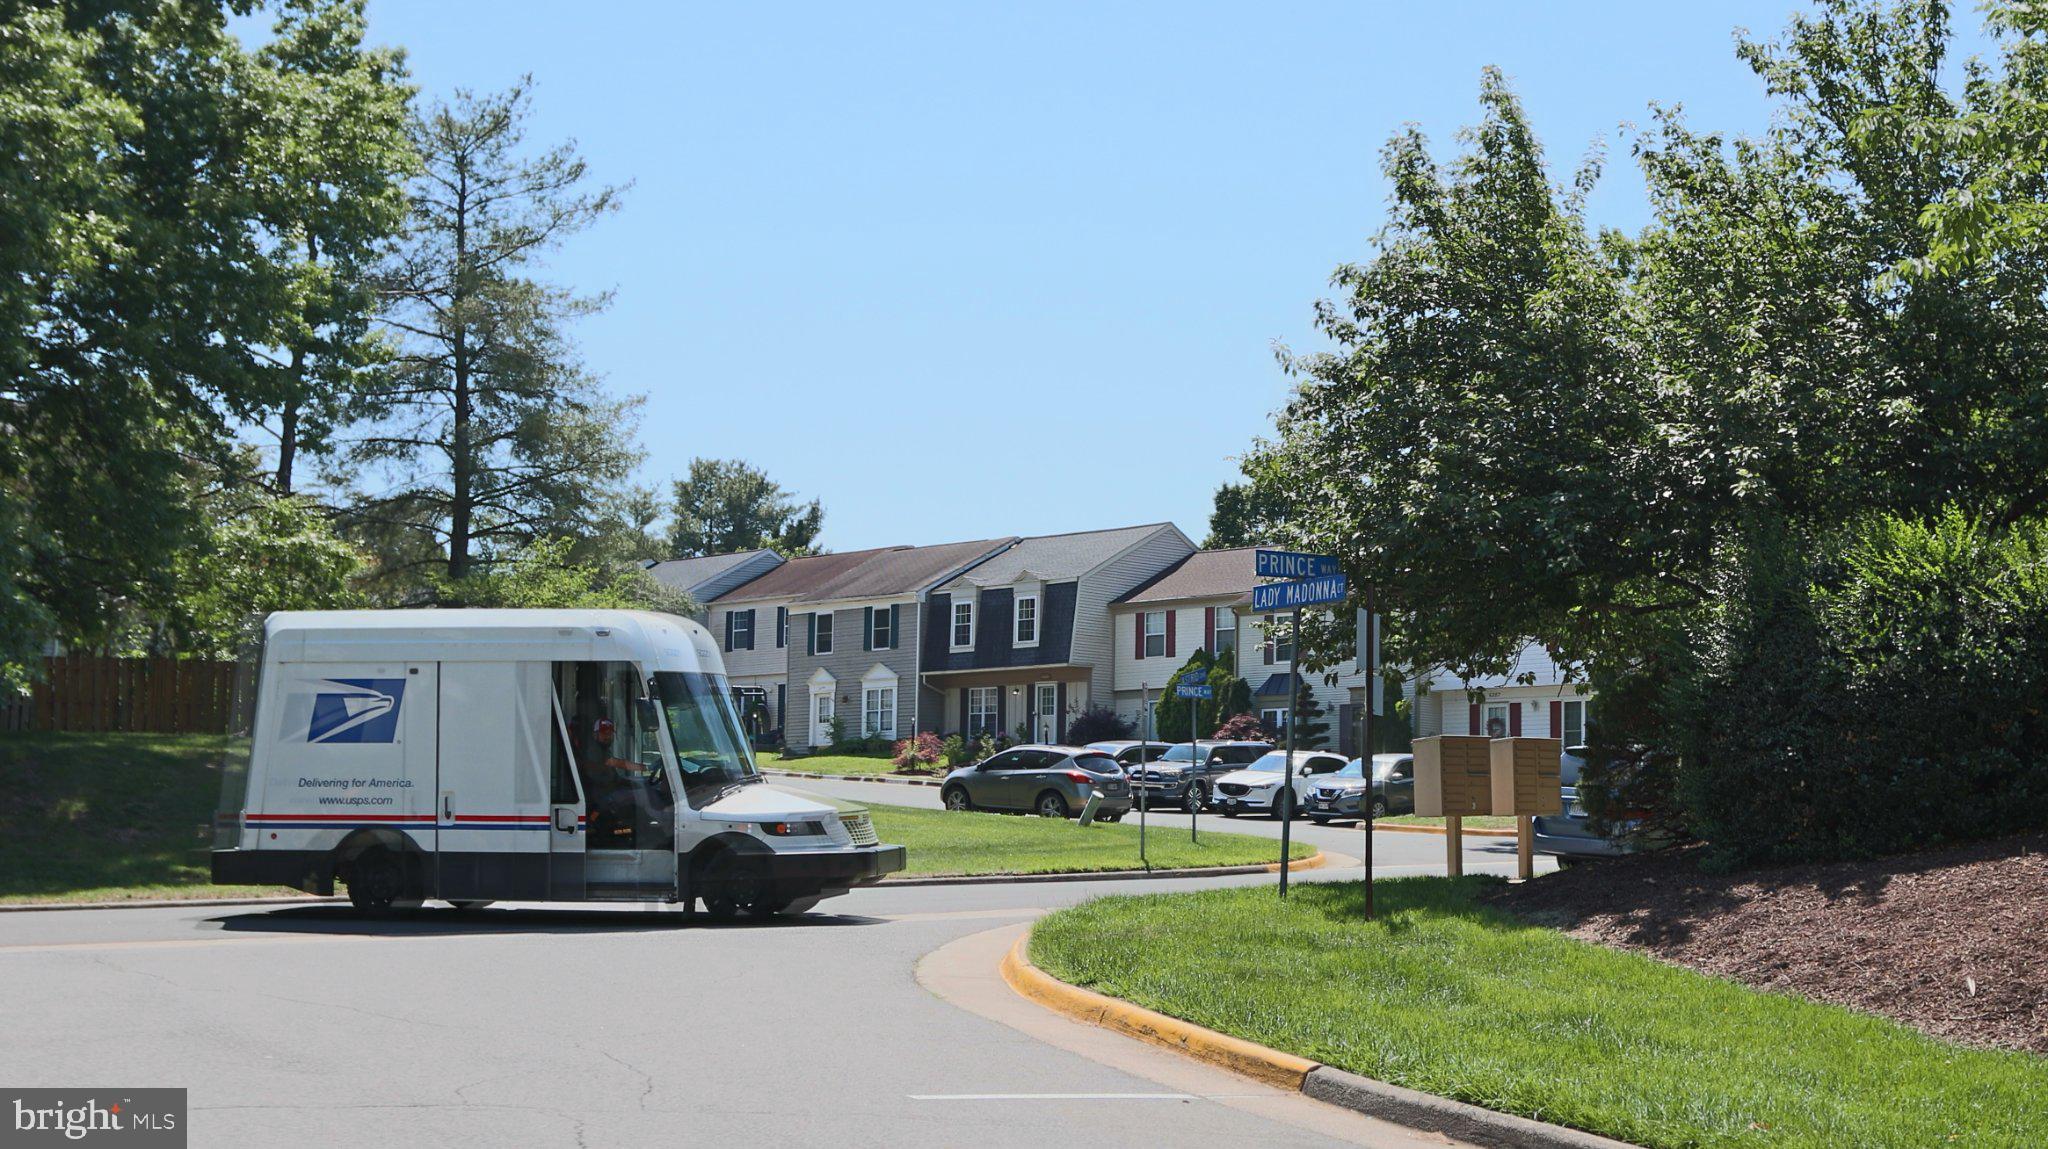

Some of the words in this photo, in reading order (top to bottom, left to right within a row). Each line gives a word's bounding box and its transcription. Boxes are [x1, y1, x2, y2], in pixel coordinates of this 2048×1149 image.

[1259, 553, 1315, 576] PRINCE
[1321, 564, 1337, 574] WAY
[1254, 586, 1281, 608] LADY
[1286, 580, 1337, 604] MADONNA
[1337, 582, 1344, 594] CT
[1176, 686, 1203, 697] PRINCE
[298, 777, 349, 790] Delivering
[351, 777, 367, 788] for
[368, 777, 415, 788] America.
[318, 795, 393, 806] www.usps.com
